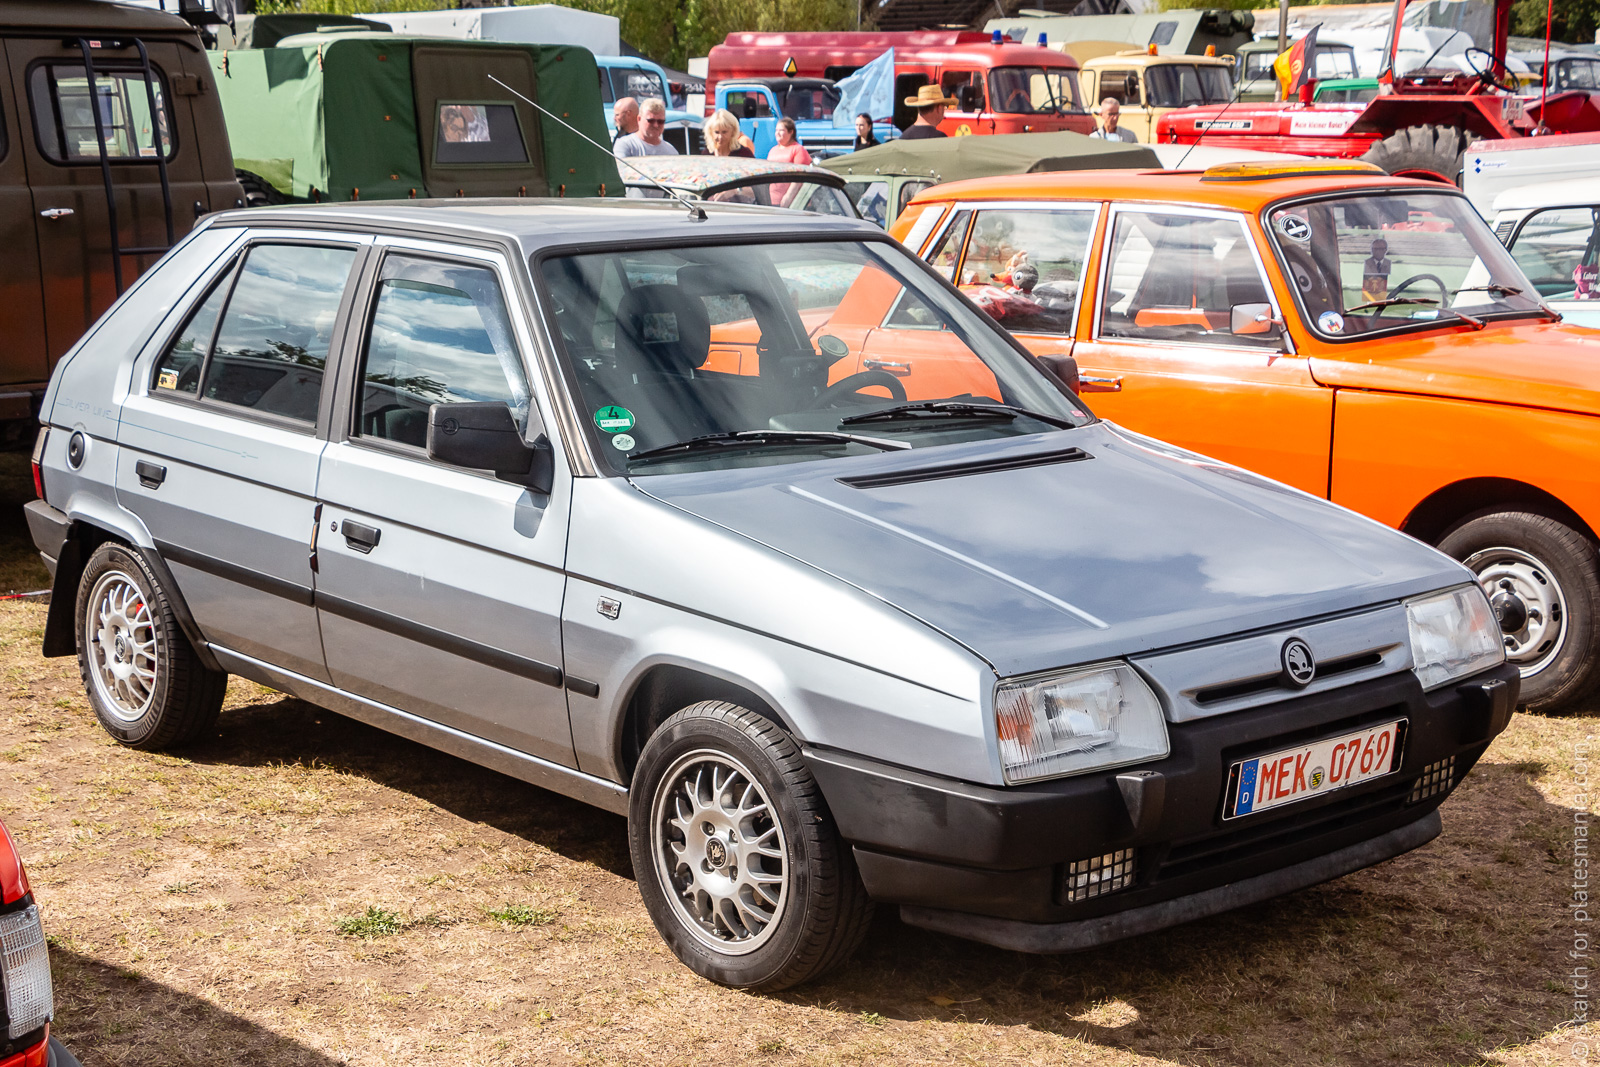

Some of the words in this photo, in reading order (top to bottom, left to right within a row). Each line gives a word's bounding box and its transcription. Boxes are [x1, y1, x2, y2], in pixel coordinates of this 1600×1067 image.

[608, 406, 620, 419] 4
[1257, 751, 1312, 804] MEK
[1329, 730, 1391, 783] 0769
[1241, 791, 1250, 804] D
